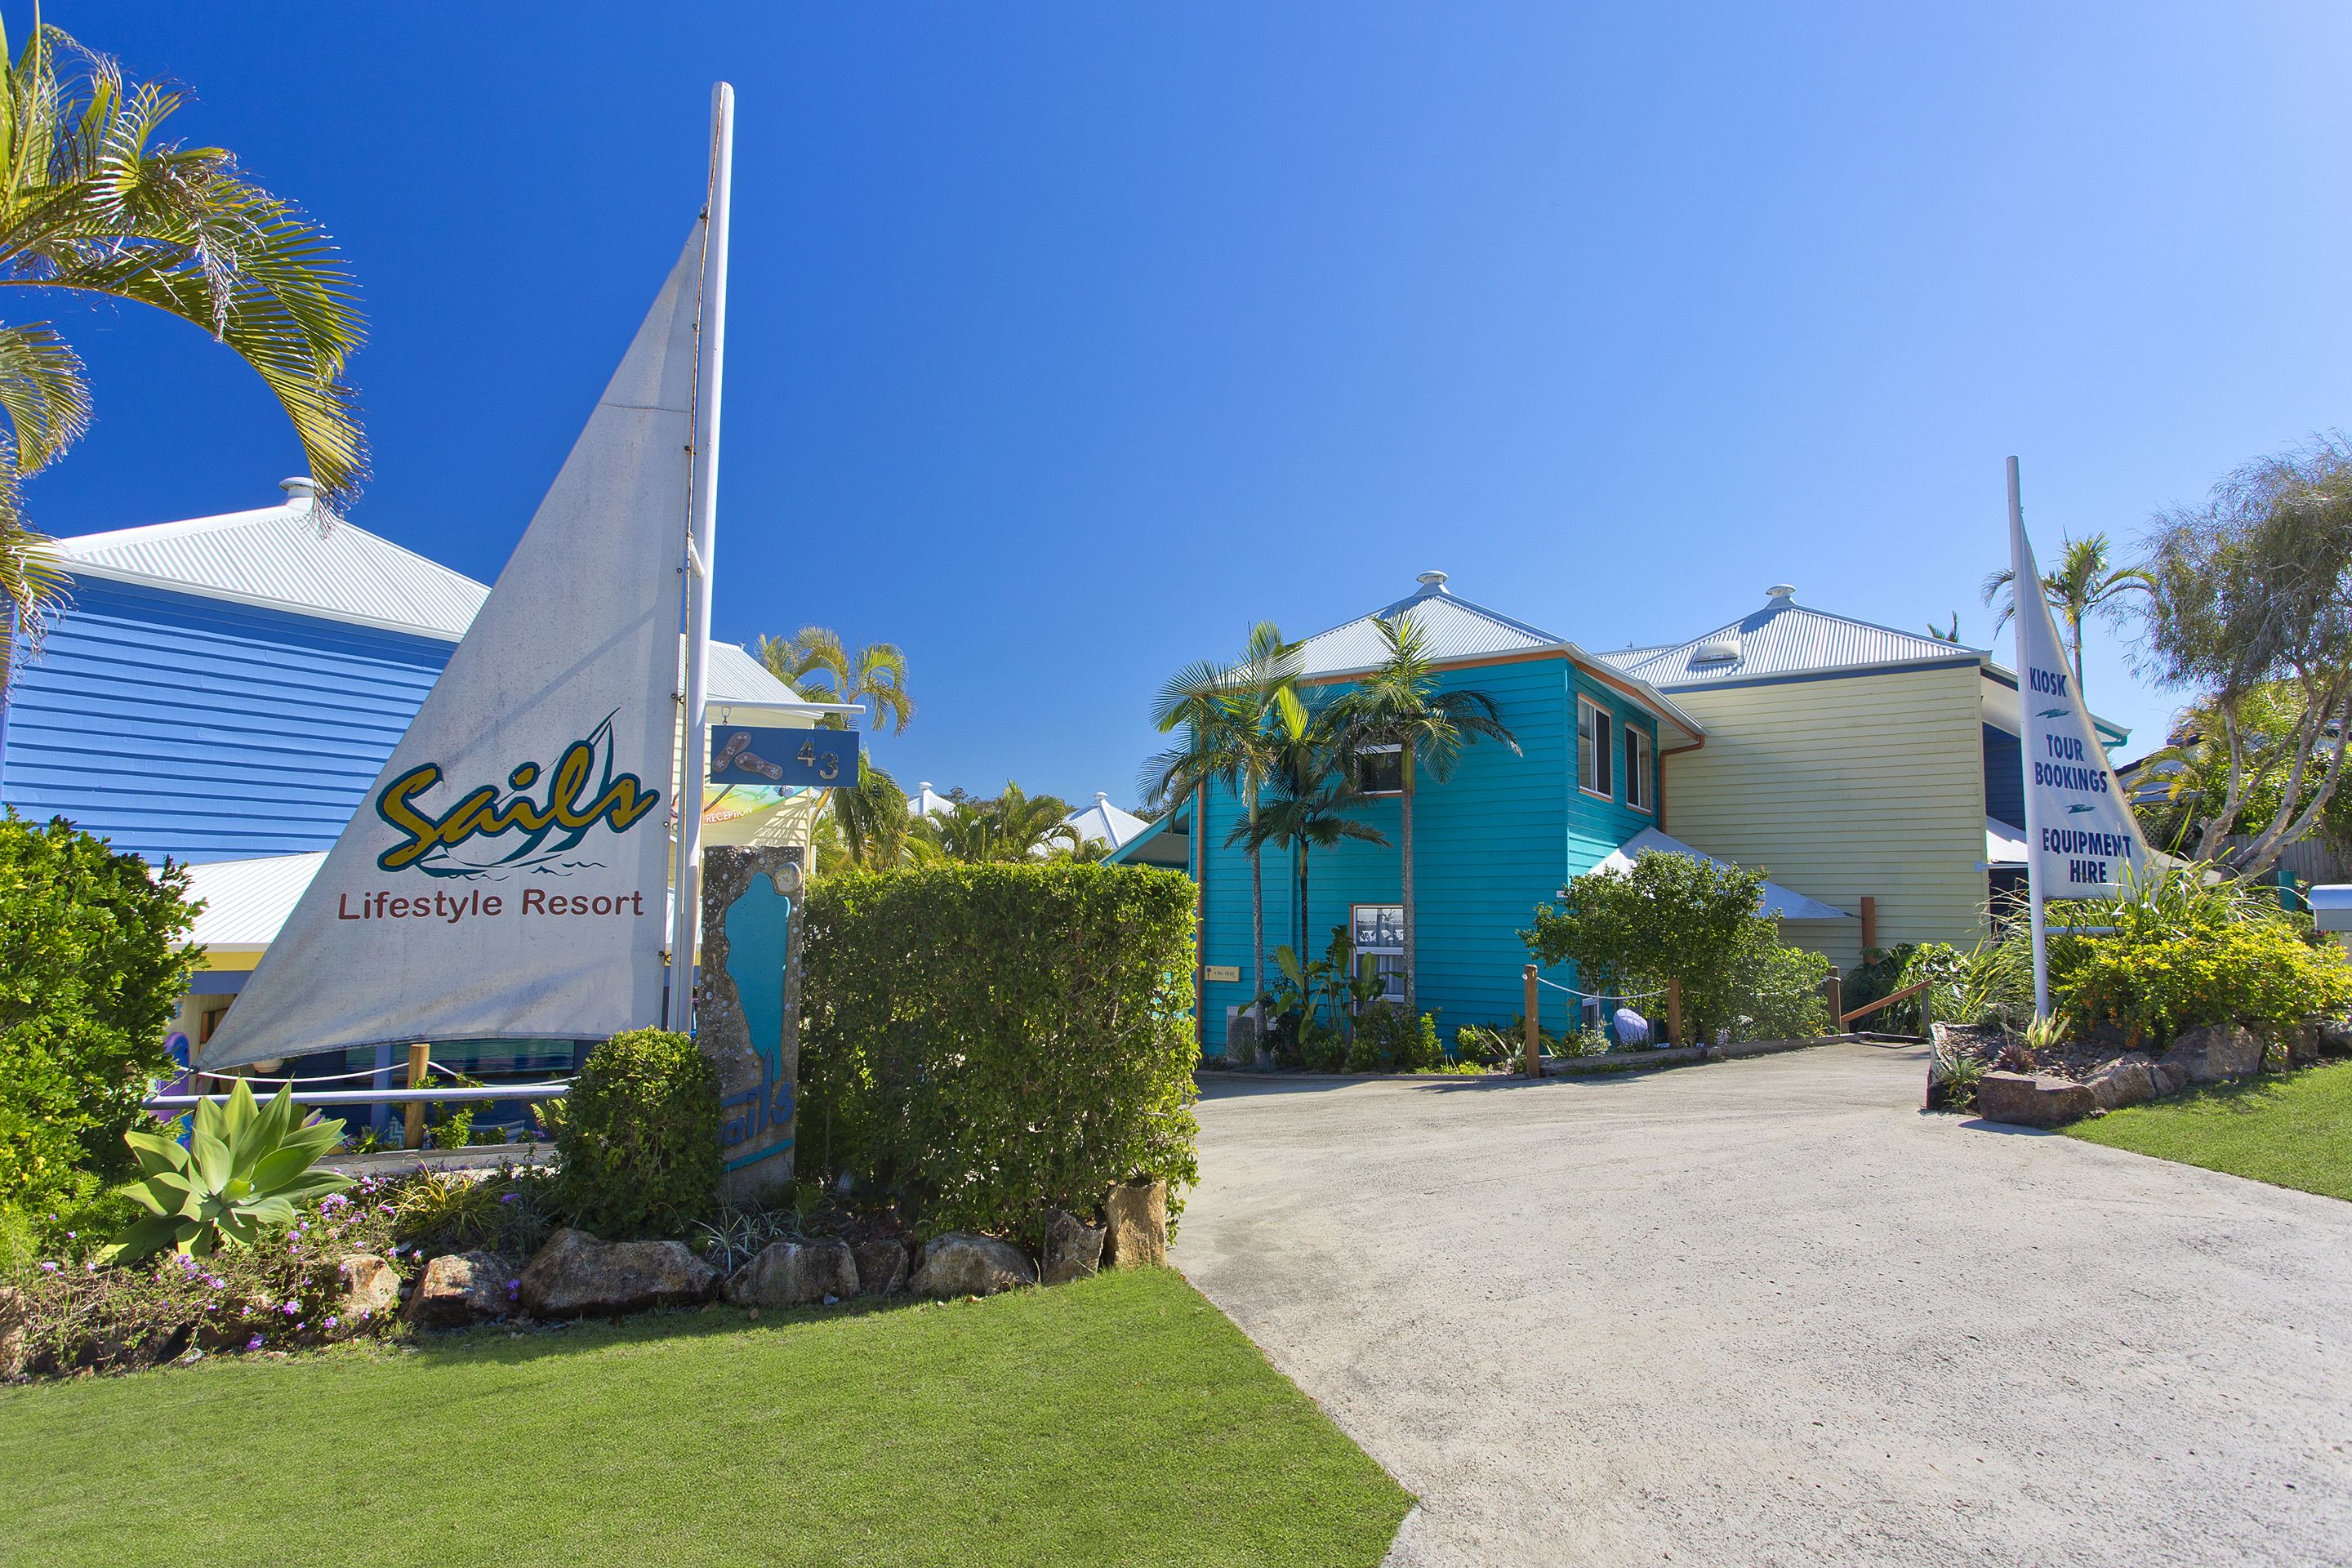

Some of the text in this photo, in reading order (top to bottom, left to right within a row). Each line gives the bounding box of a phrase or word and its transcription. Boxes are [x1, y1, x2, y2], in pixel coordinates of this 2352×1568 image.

[2029, 666, 2068, 697] KIOSK
[796, 737, 840, 780] 43
[2046, 733, 2084, 762] TOUR
[2034, 761, 2108, 794] BOOKINGS
[375, 739, 661, 872] Sails
[705, 805, 753, 823] RECEPTION
[2042, 827, 2132, 858] EQUIPMENT
[2069, 859, 2108, 884] HIRE
[337, 888, 644, 924] Lifestyle Resort
